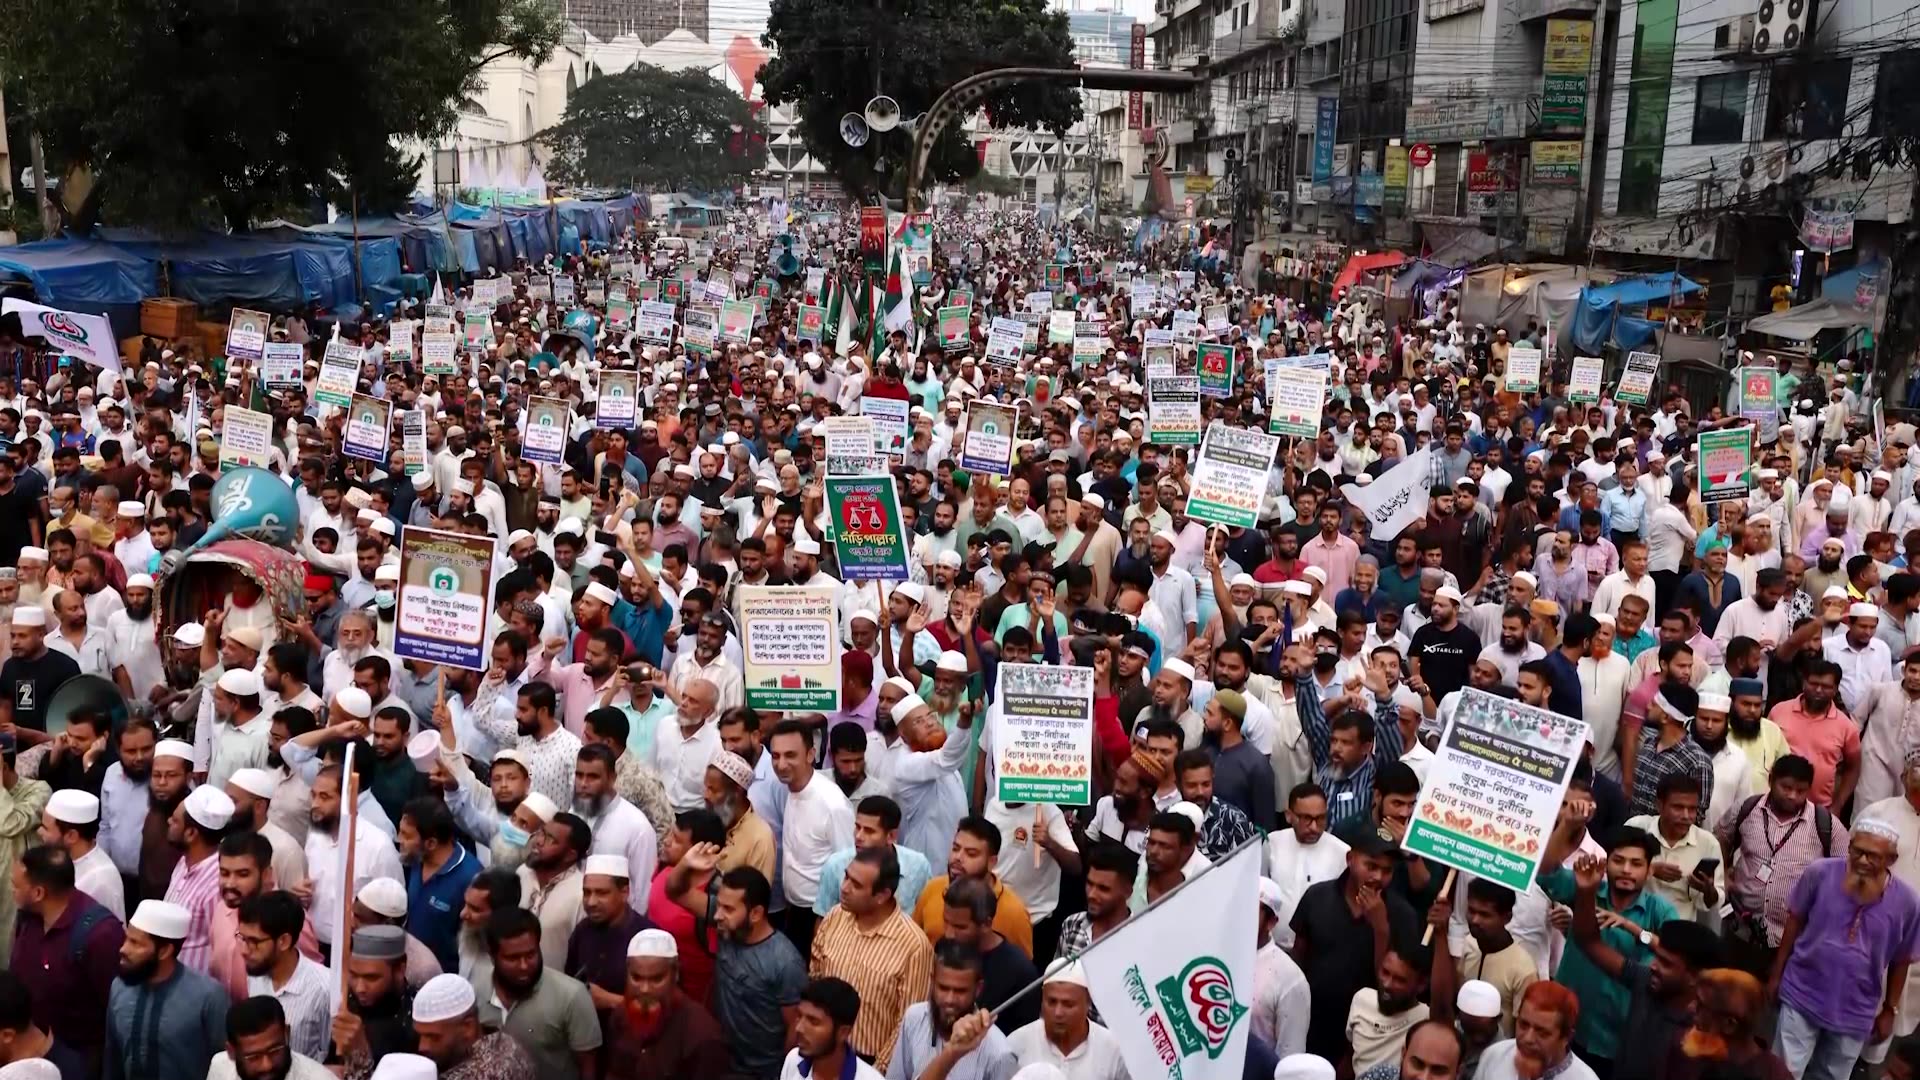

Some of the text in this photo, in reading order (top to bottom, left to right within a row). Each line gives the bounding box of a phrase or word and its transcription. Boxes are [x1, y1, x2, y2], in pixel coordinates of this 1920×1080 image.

[840, 531, 896, 545] দাঁড়িপাল্লার
[19, 684, 33, 705] 2
[1456, 727, 1491, 743] বাংলাদেশ
[1531, 750, 1564, 768] ইসলামীর
[1512, 756, 1521, 766] ৫
[1462, 773, 1527, 801] জুলুম-নির্যাতন
[1484, 765, 1525, 785] সরকারের
[1529, 780, 1553, 793] সকল
[1431, 789, 1457, 806] বিচার
[1496, 814, 1521, 829] করতে
[1524, 824, 1541, 836] হবে
[1449, 783, 1532, 818] গণহত্যা ও দুর্নীতির
[1417, 827, 1455, 846] বাংলাদেশ
[1495, 854, 1526, 872] ইসলামী
[1122, 964, 1153, 1015] বাংলাদেশ
[1147, 1011, 1176, 1066] জামায়াতে
